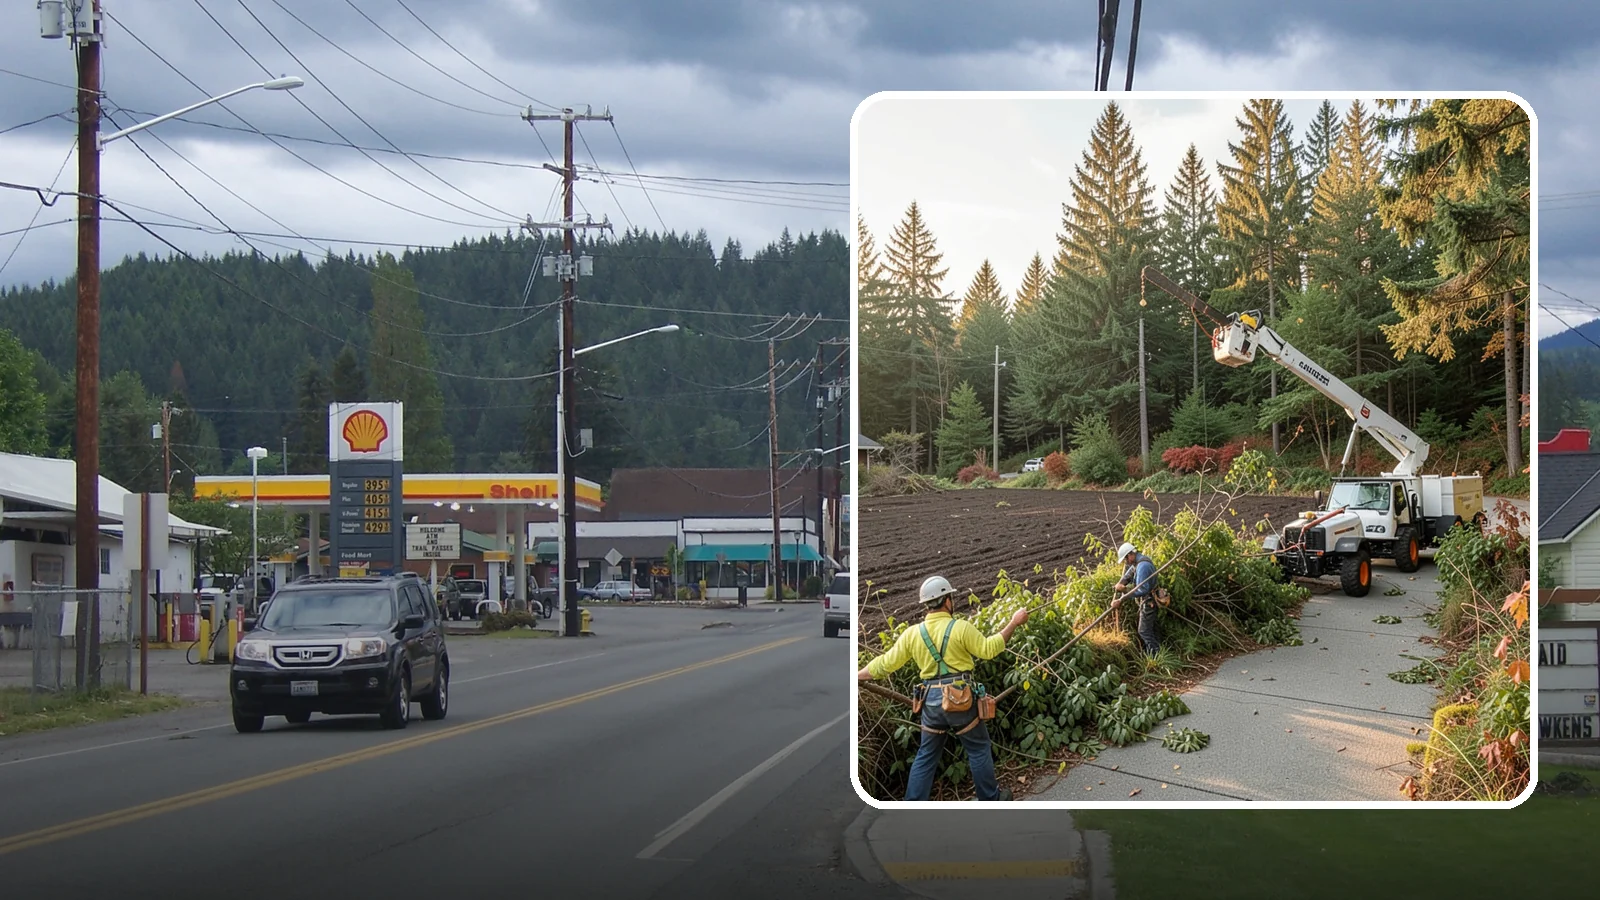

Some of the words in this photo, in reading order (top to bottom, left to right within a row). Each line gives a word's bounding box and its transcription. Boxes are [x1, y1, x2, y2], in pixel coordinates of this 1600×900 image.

[365, 480, 384, 490] 395
[490, 484, 547, 499] Shell
[365, 494, 384, 504] 405
[365, 508, 383, 518] 415
[366, 522, 383, 532] 429
